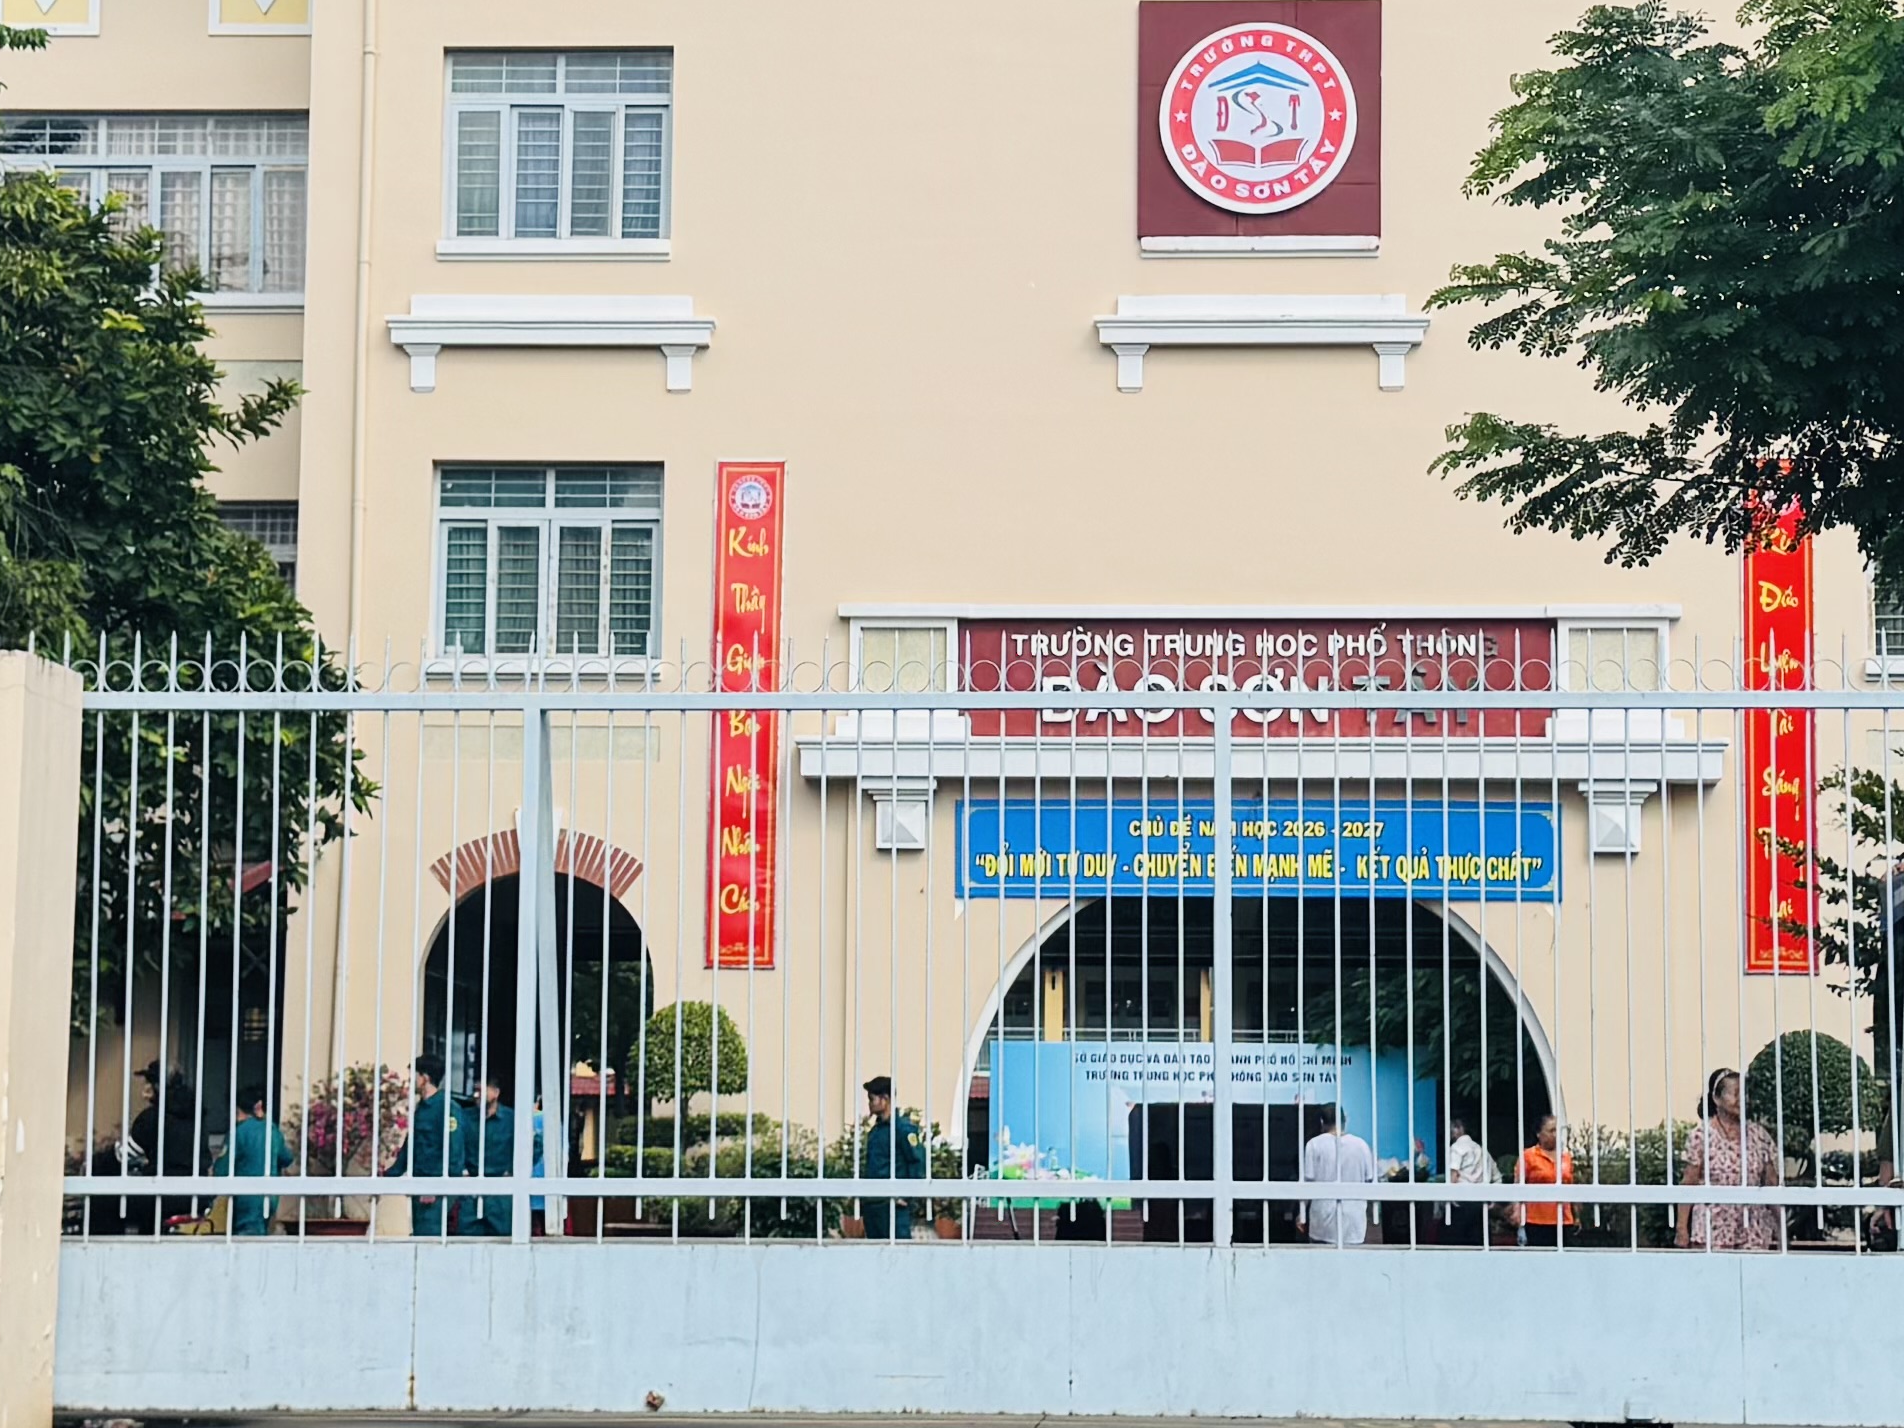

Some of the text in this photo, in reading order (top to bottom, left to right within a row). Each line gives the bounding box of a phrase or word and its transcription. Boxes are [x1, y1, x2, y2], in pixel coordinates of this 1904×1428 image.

[1181, 34, 1337, 91] TRƯỜNG THPT
[1181, 139, 1337, 199] ĐÀO SƠN TÂY
[728, 526, 769, 557] Kính
[731, 582, 766, 634] Thầy
[1011, 626, 1134, 658] TRƯỜNG
[1147, 634, 1245, 658] TRUNG
[1762, 766, 1800, 821] Sáng
[1243, 821, 1277, 840] HỌC
[1283, 820, 1326, 837] 2026
[1342, 821, 1384, 838] 2027
[1084, 853, 1117, 878] DUY
[1133, 842, 1202, 878] CHUYỂN
[1253, 853, 1300, 883] MẠNH
[1307, 849, 1333, 879] MẼ
[1395, 847, 1430, 884] QUẢ
[1086, 1070, 1129, 1081] TRƯNG
[1231, 1070, 1262, 1082] HÔNG
[1164, 1053, 1186, 1064] ĐÀ
